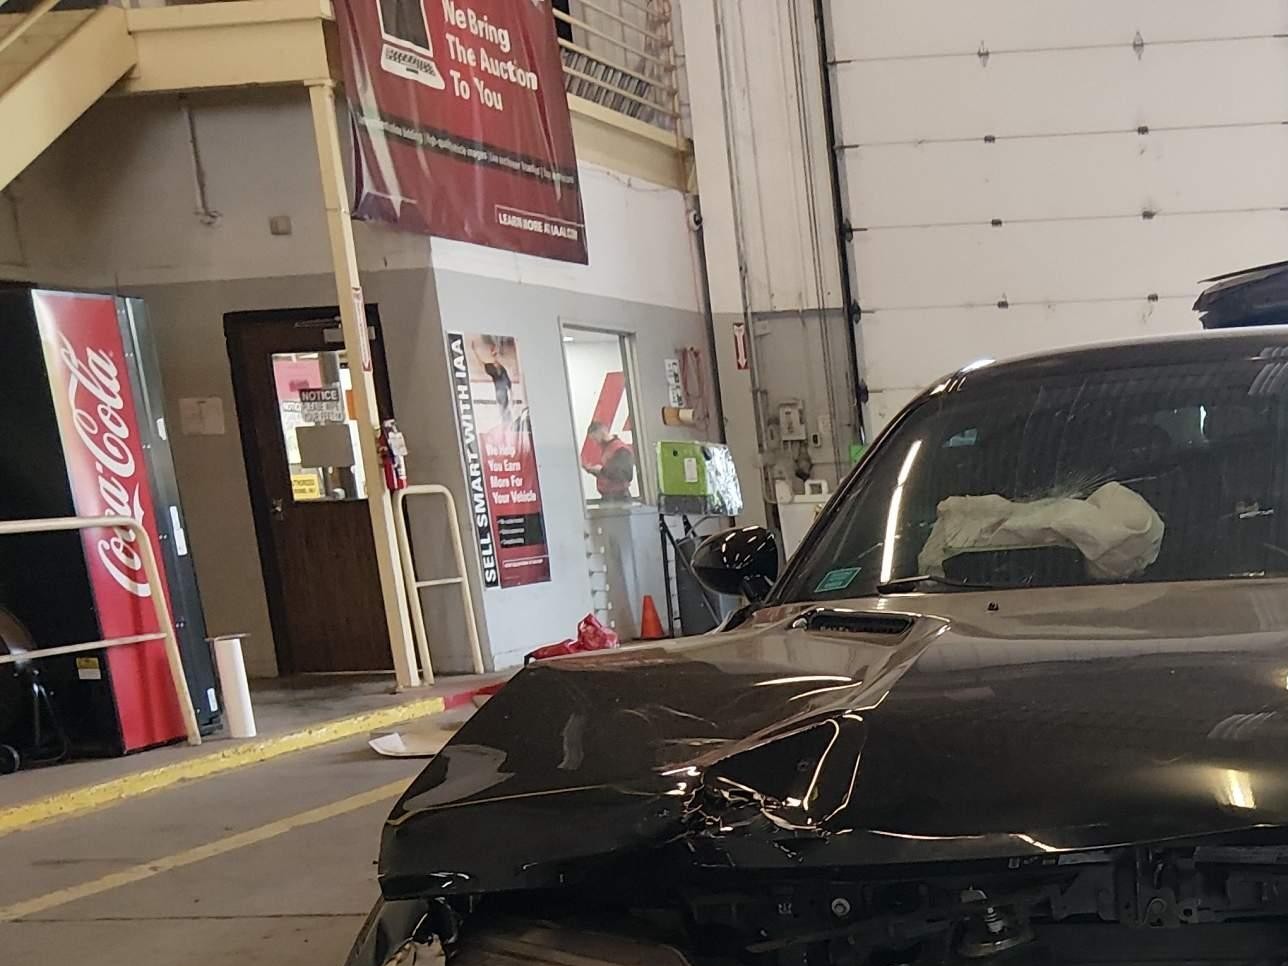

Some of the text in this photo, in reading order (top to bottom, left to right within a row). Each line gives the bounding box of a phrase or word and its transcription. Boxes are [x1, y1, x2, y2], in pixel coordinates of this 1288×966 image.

[445, 33, 477, 67] The
[467, 8, 511, 52] Bring
[449, 69, 504, 111] To You
[302, 390, 339, 401] NOTICE
[451, 338, 497, 583] SELL SMART WITH IAA
